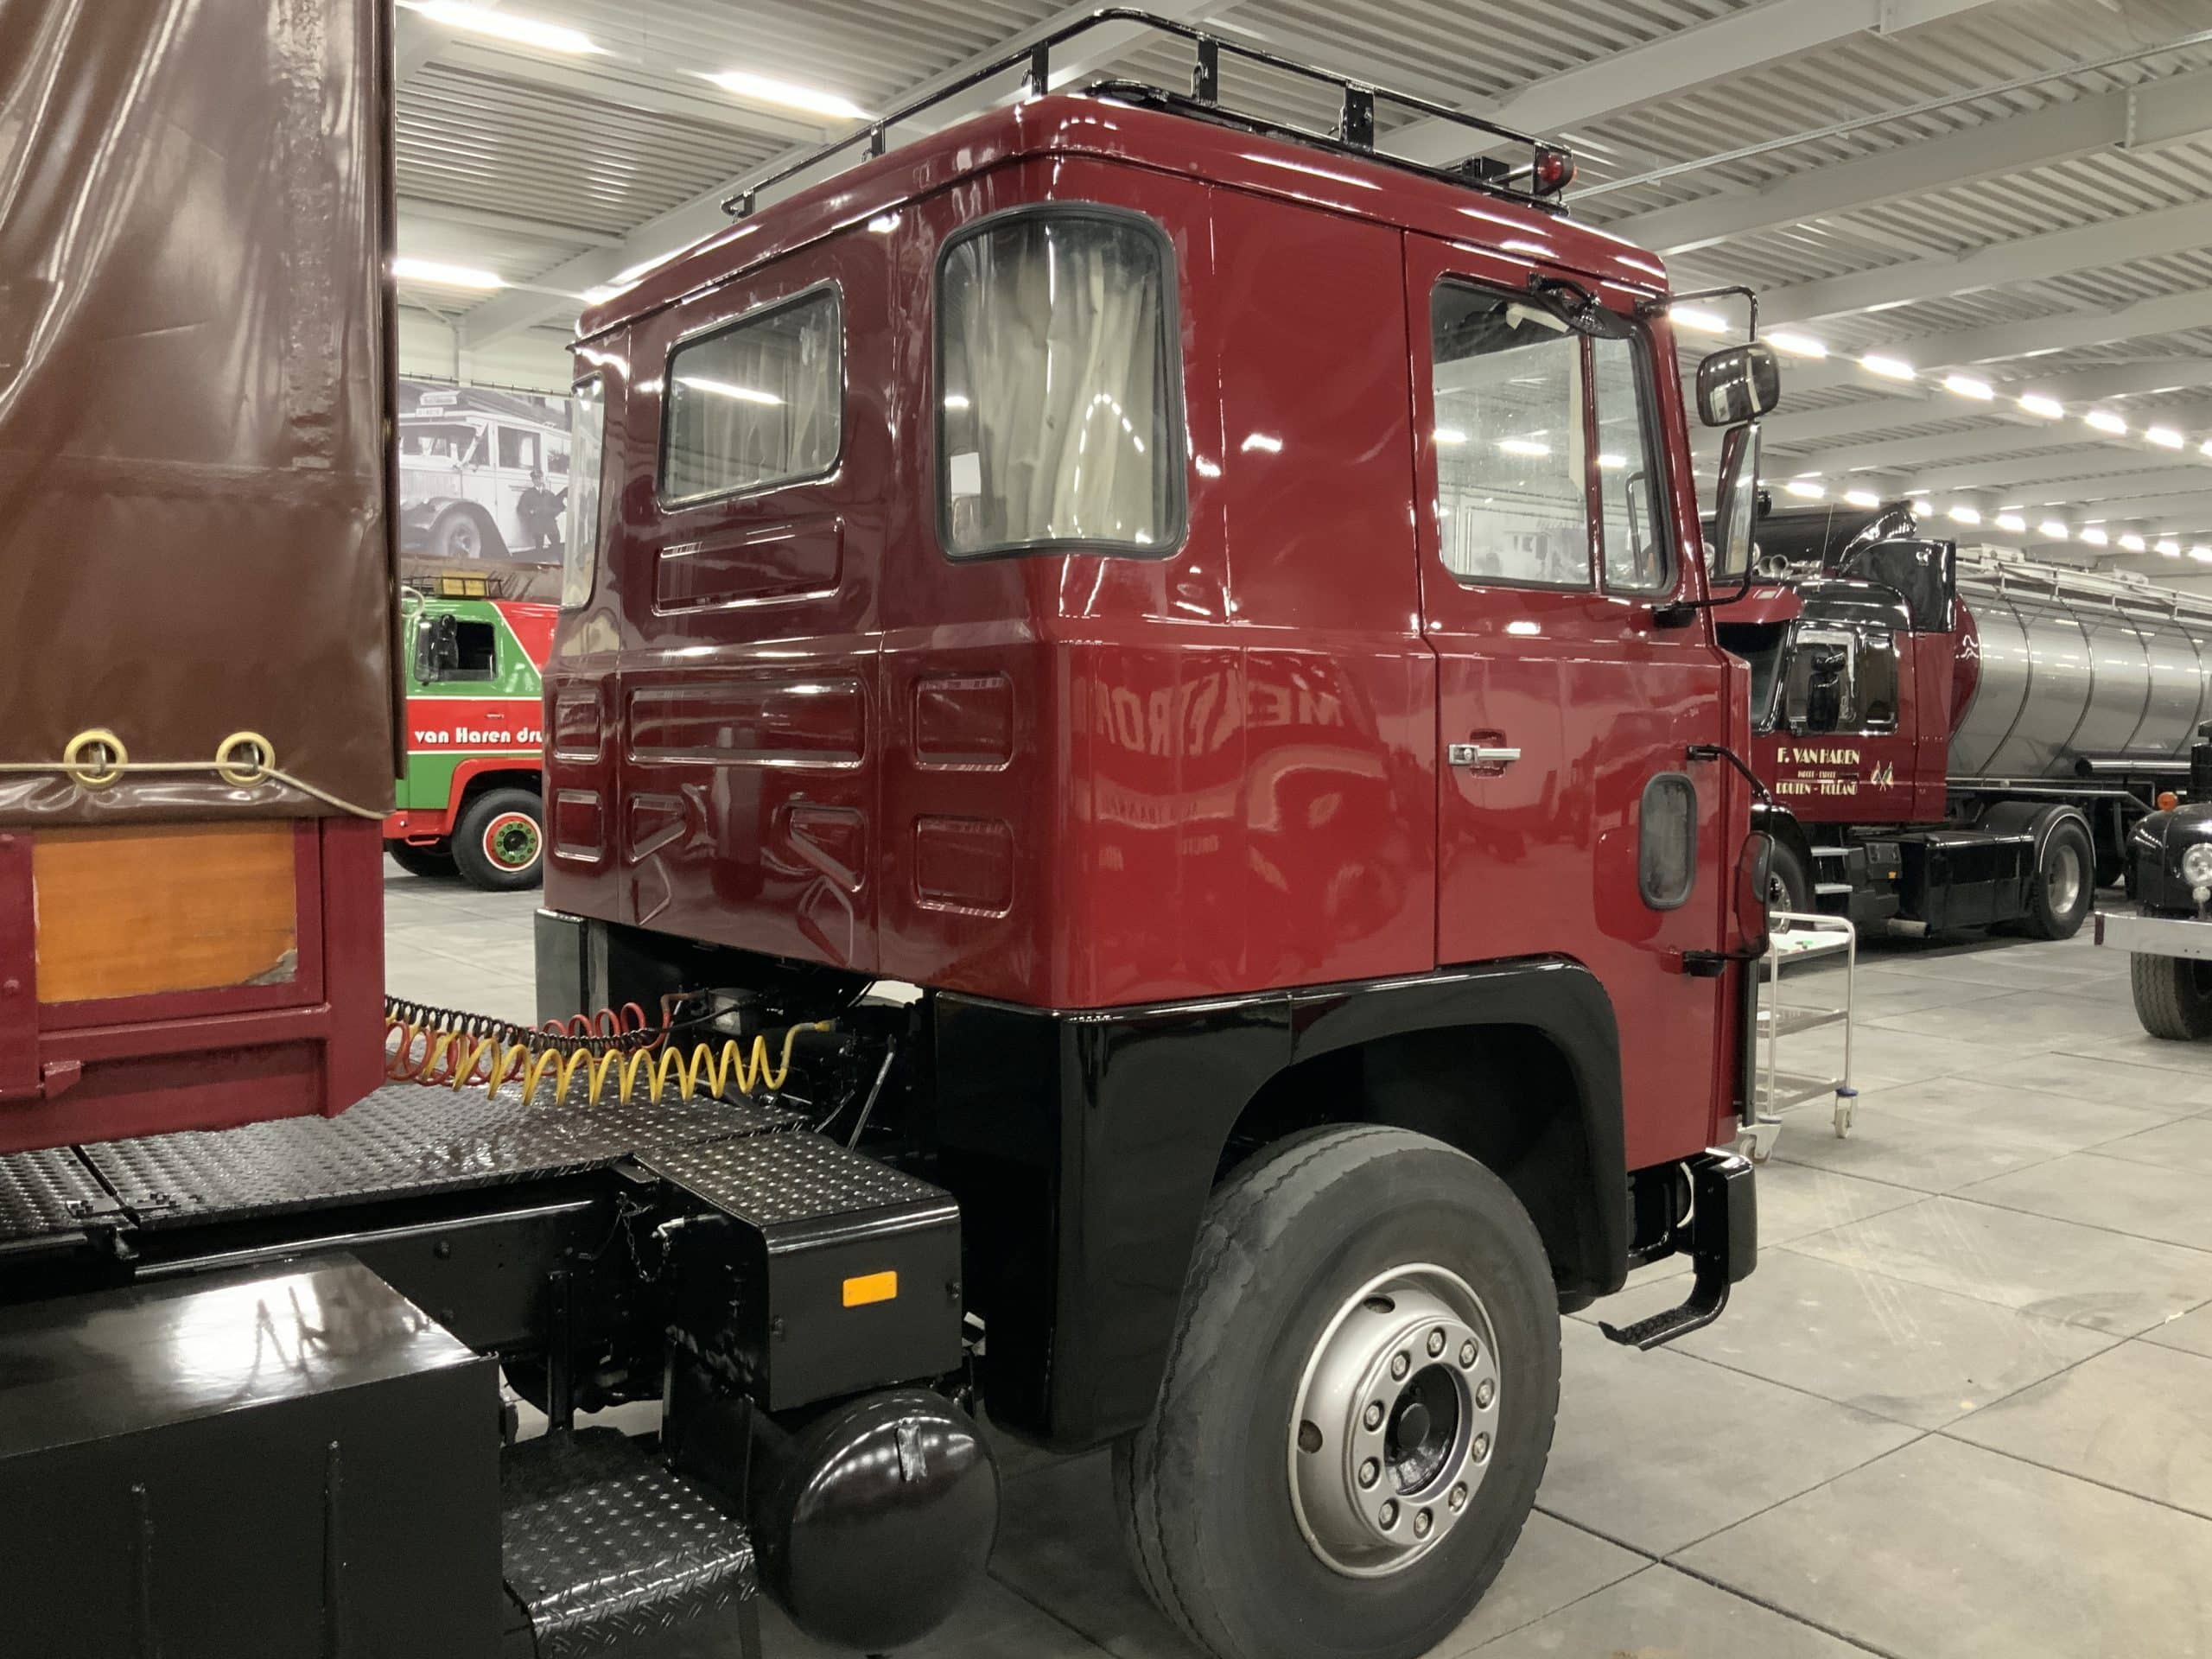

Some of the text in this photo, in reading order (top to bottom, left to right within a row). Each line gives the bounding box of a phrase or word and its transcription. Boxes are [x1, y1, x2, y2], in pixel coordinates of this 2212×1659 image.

[415, 731, 449, 743] van
[455, 727, 512, 743] Haren
[1777, 747, 1859, 765] F. VAN HAREN
[1776, 782, 1811, 795] DRUTEN
[1821, 782, 1858, 796] HOLLAND
